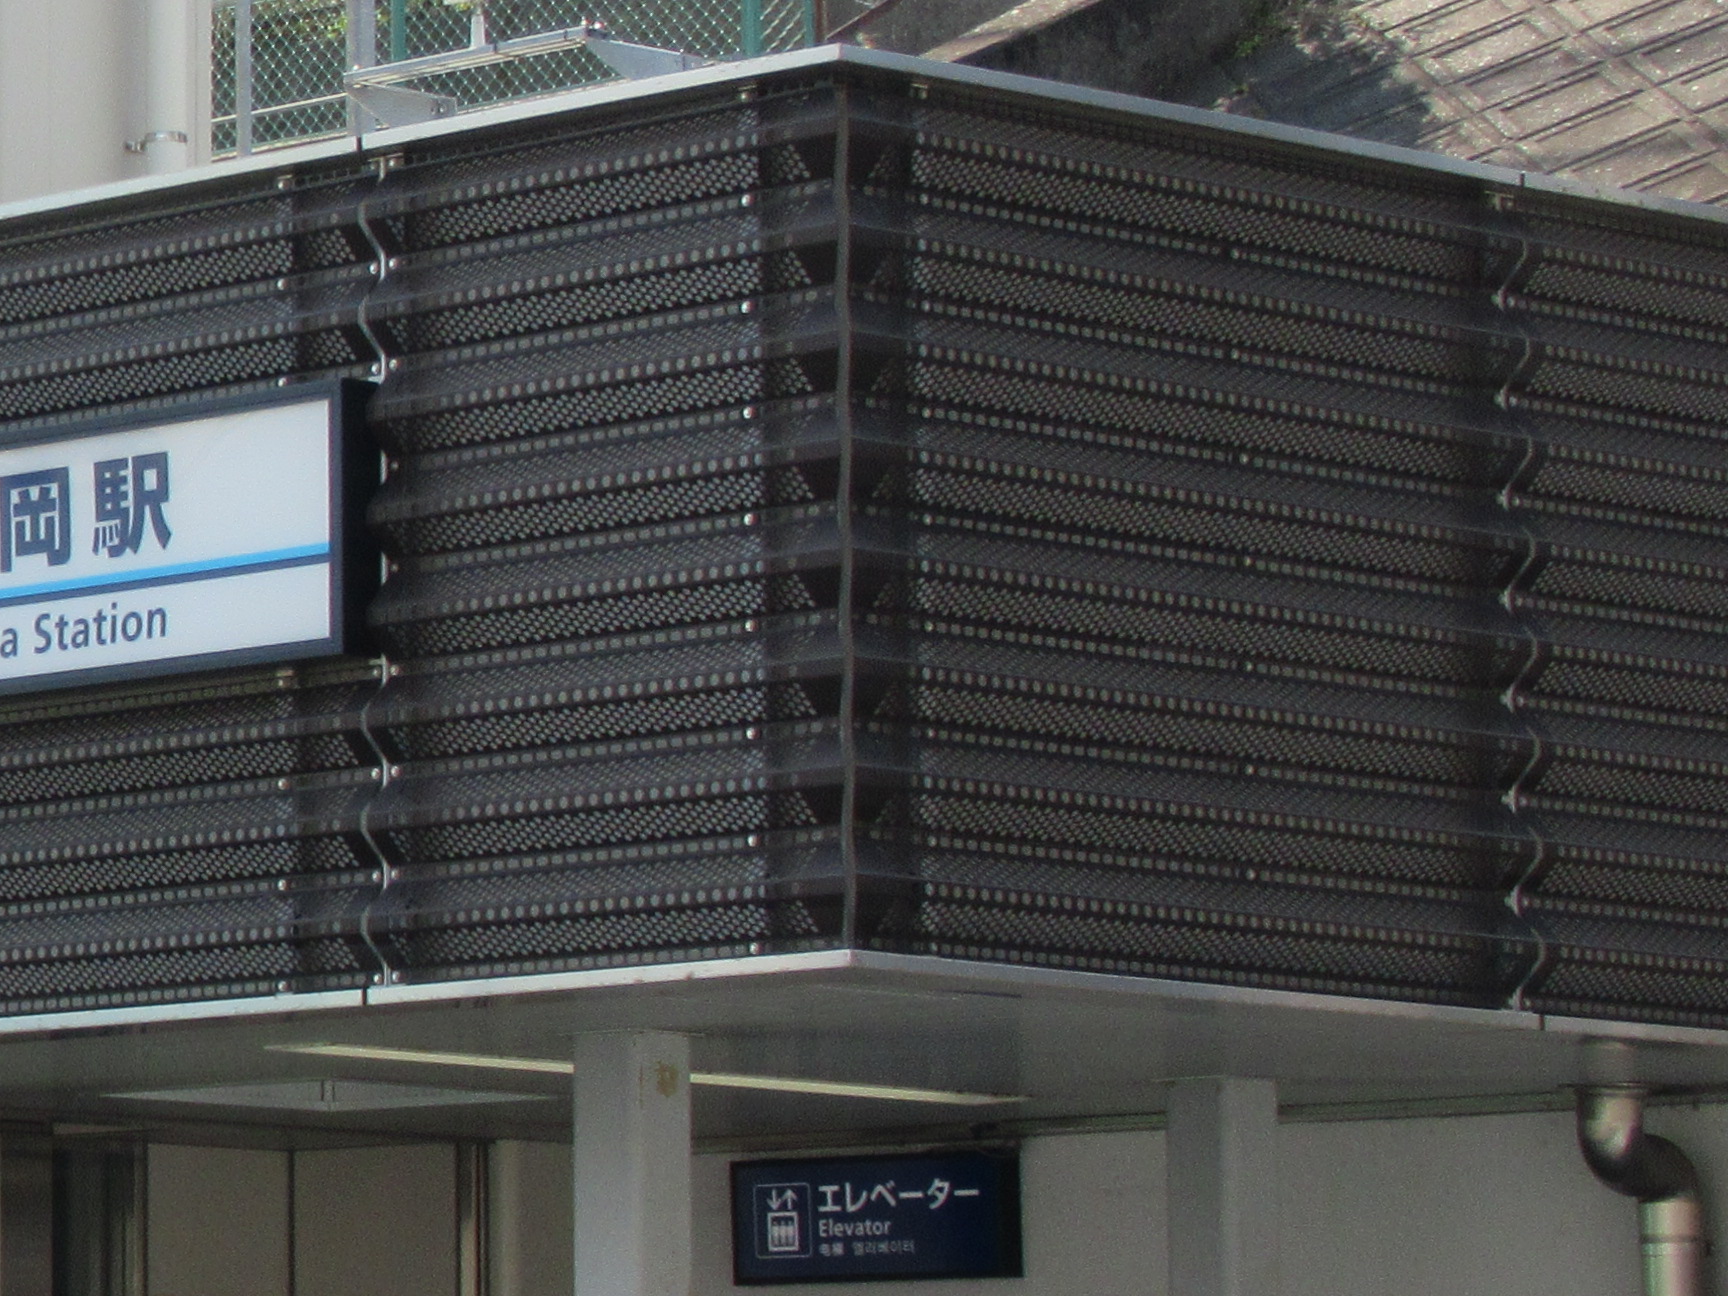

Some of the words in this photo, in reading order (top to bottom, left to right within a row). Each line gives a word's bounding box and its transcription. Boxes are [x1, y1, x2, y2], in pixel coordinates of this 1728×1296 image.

[33, 603, 167, 655] Station
[817, 1178, 980, 1212] エレベーター
[819, 1219, 891, 1237] Elevator
